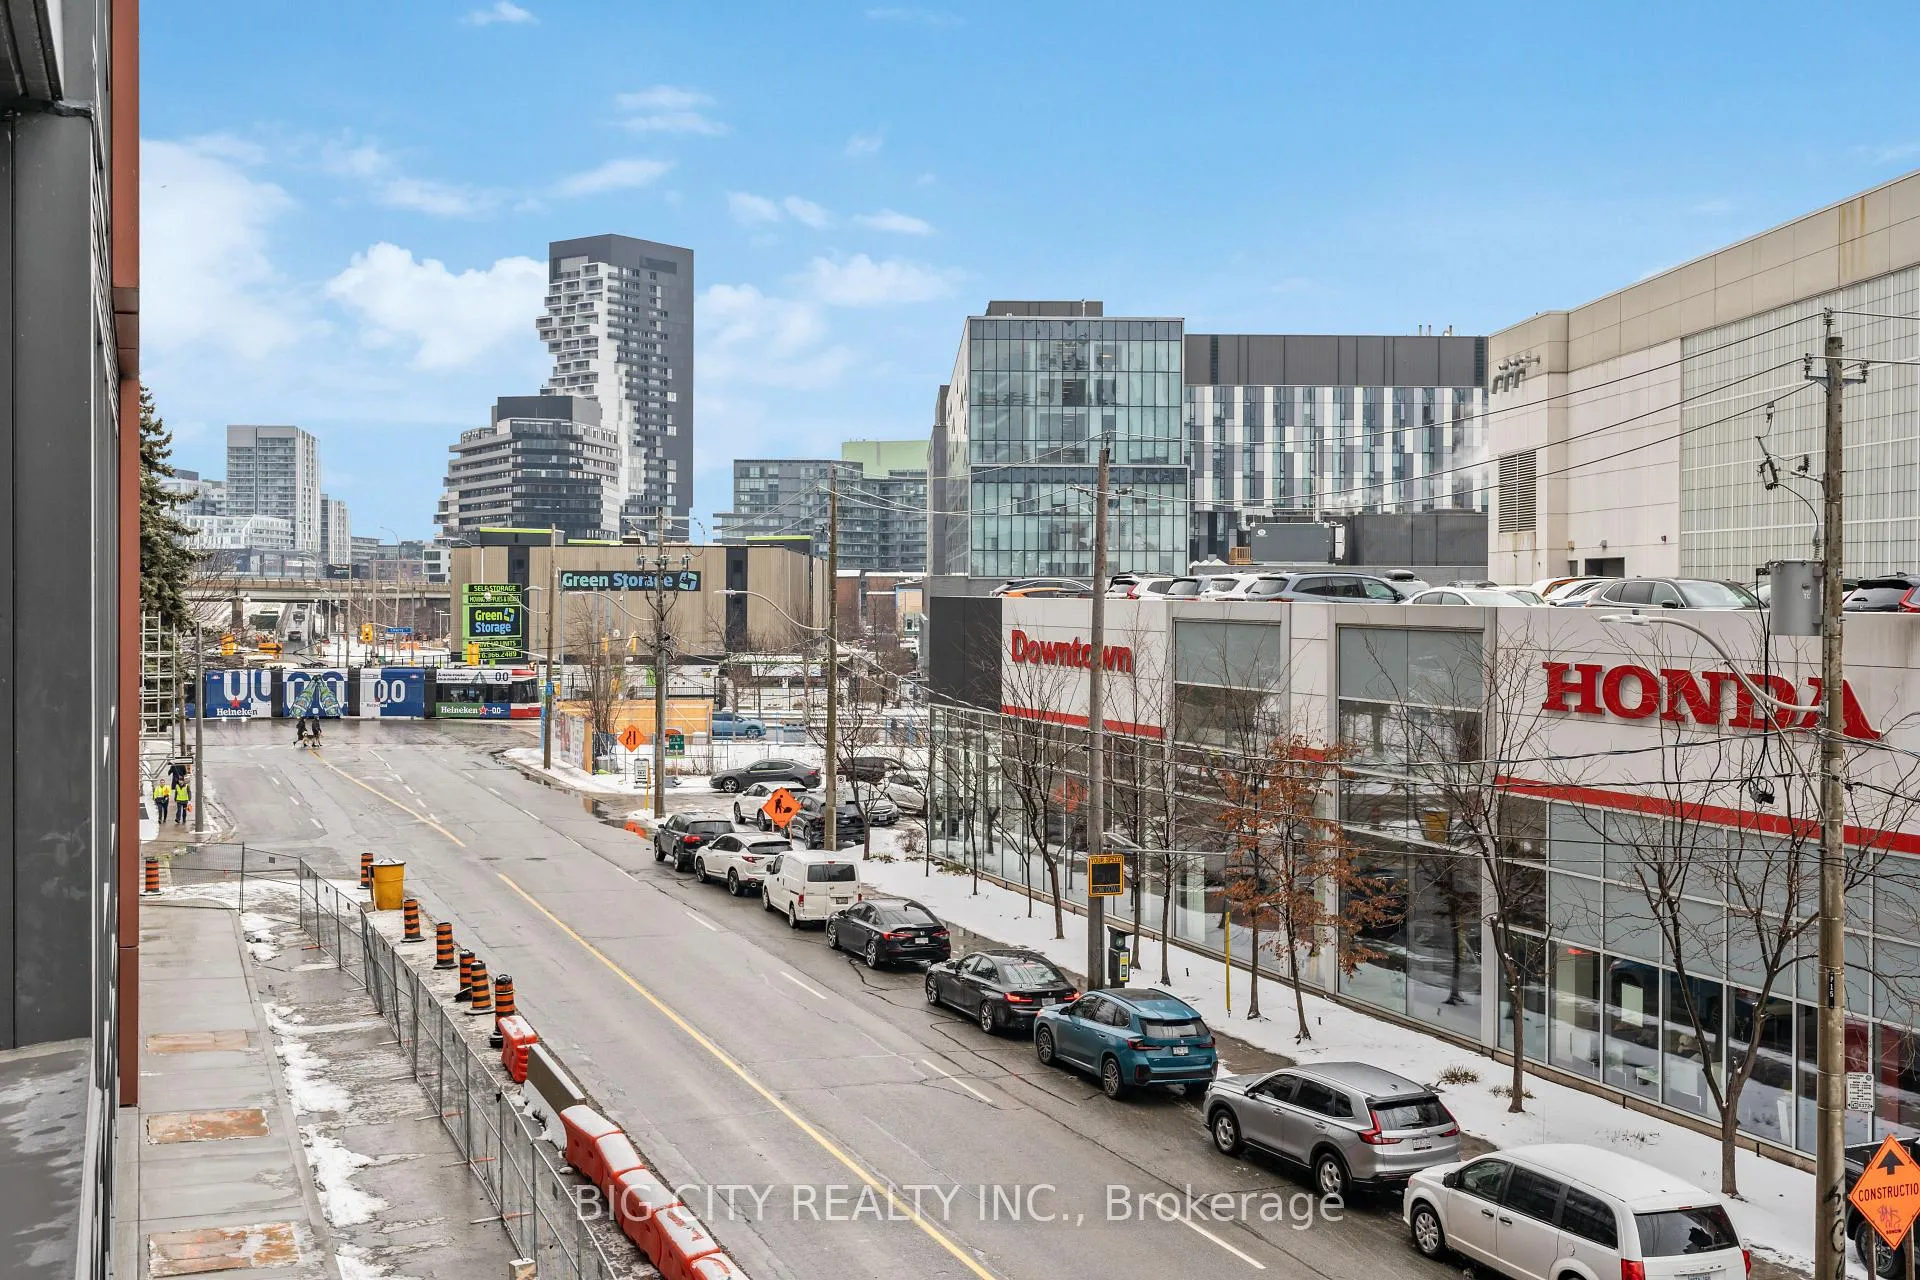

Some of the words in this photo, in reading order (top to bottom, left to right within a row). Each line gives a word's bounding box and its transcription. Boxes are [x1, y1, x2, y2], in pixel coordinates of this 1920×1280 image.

[562, 573, 608, 587] Green
[613, 573, 673, 588] Storae
[475, 610, 503, 621] Green
[475, 622, 511, 635] Storage
[1011, 629, 1133, 673] Downtown
[1541, 661, 1882, 741] HONDA
[216, 708, 258, 717] Heineken
[441, 706, 478, 714] Heineken
[1858, 1182, 1919, 1202] CONSTRUCTIO
